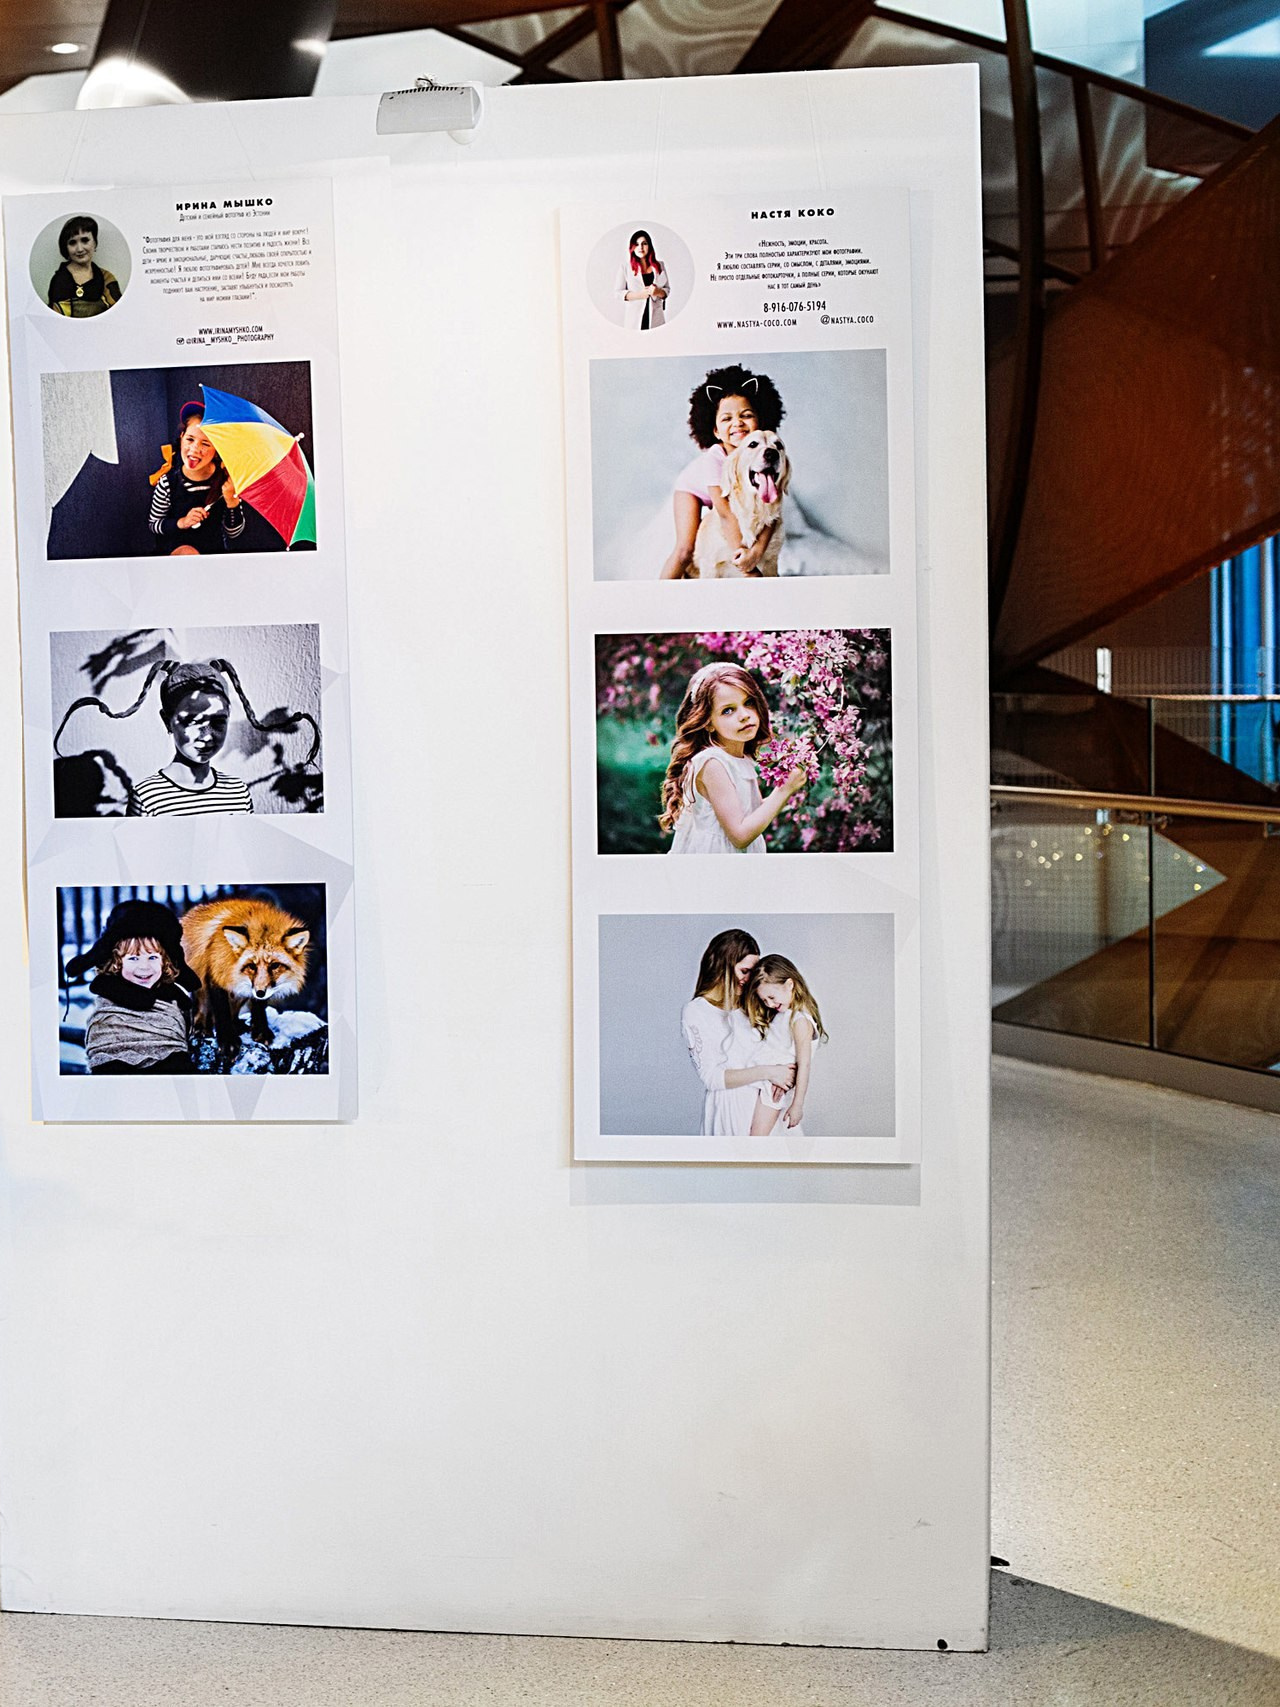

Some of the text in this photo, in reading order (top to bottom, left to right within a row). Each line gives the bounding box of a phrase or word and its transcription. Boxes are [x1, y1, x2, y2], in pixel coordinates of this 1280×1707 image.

[176, 198, 273, 211] ИРИНА МЫШКО
[751, 207, 836, 220] НАСТЯ КОКО
[763, 300, 826, 313] 8-916-076-5194
[716, 318, 797, 328] WWW.NASTYA-COCO.COM
